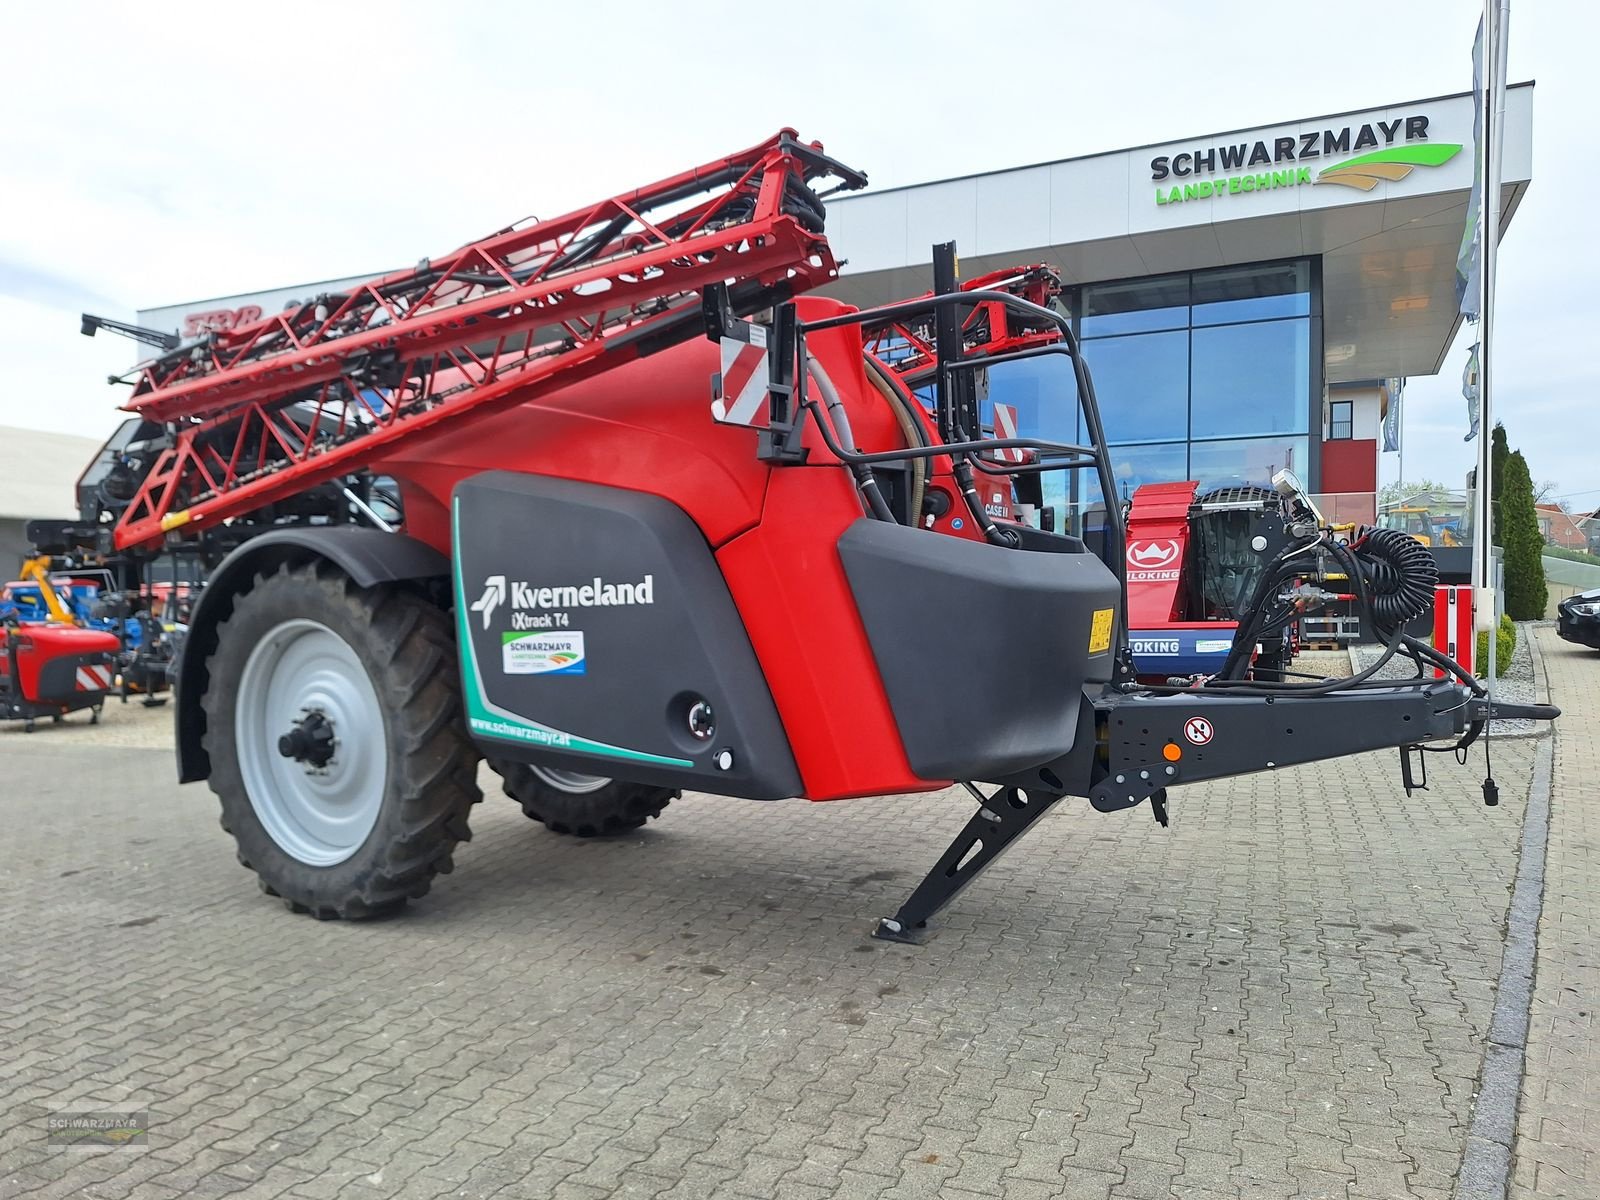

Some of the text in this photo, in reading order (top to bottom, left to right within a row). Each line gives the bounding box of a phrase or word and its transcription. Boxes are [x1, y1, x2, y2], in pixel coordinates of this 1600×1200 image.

[1150, 115, 1431, 181] SCHWARZMAYR
[1155, 166, 1312, 205] LANDTECHNIK
[985, 503, 1003, 518] CASE
[1127, 571, 1180, 580] ILOKING
[511, 574, 654, 609] Kverneland
[511, 611, 569, 630] iXtrack T4
[510, 642, 572, 651] SCHWARZMAYR
[470, 717, 571, 746] www.schwarzmayr.at
